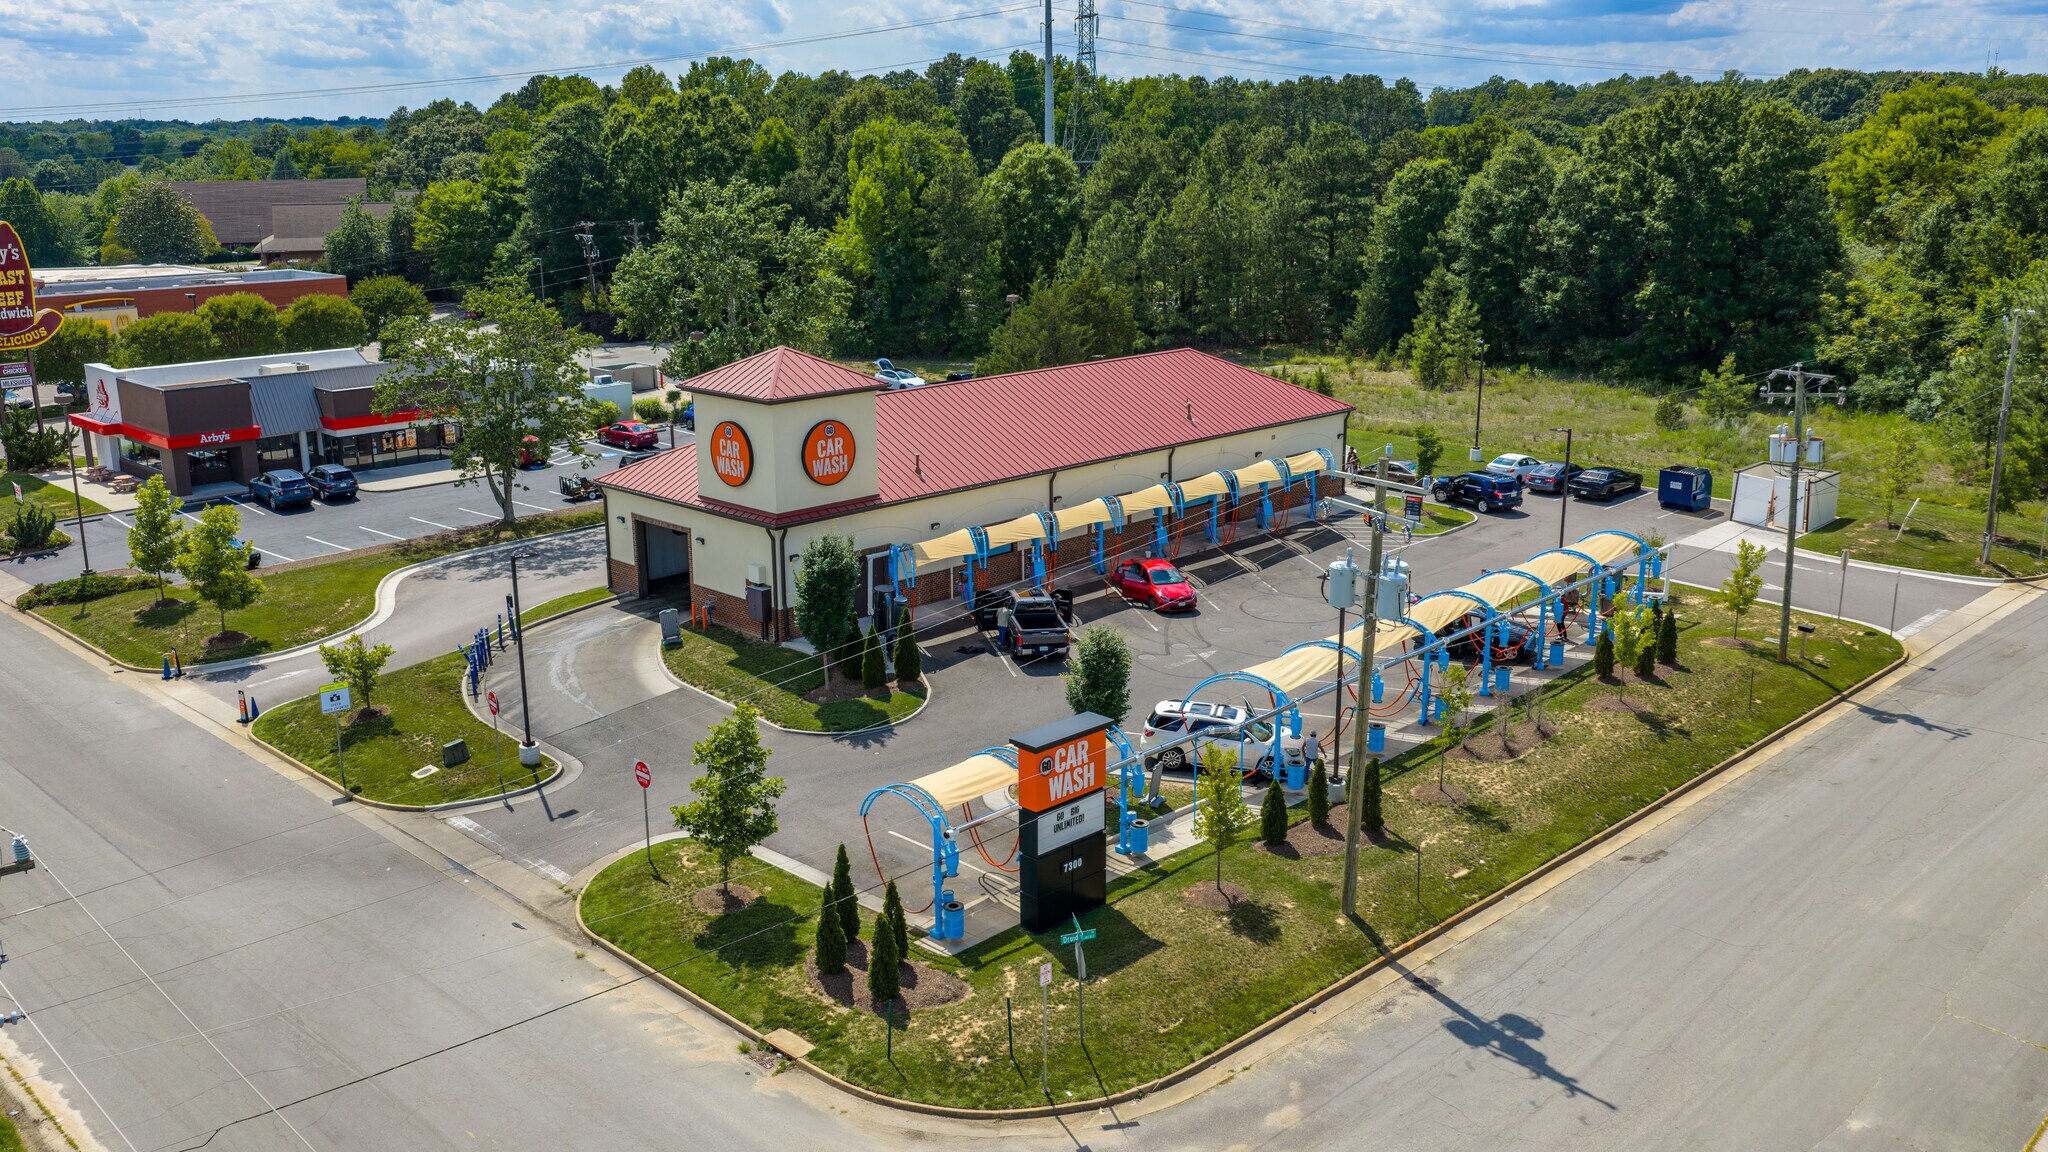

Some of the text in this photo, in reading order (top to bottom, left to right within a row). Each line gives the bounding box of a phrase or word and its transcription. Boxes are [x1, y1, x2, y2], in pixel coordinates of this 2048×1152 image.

[3, 367, 28, 375] CHICKEN
[2, 378, 31, 388] MILKSHAKES
[200, 431, 231, 443] Arby's
[719, 438, 740, 459] CAR
[817, 437, 844, 458] CAR
[716, 456, 745, 478] WASH
[812, 455, 849, 477] WASH
[1041, 740, 1089, 774] GO CAR
[1048, 762, 1095, 802] WASH
[1053, 813, 1085, 833] UNLIMITED!
[1056, 805, 1080, 822] GO BIG
[1063, 858, 1083, 873] 7300
